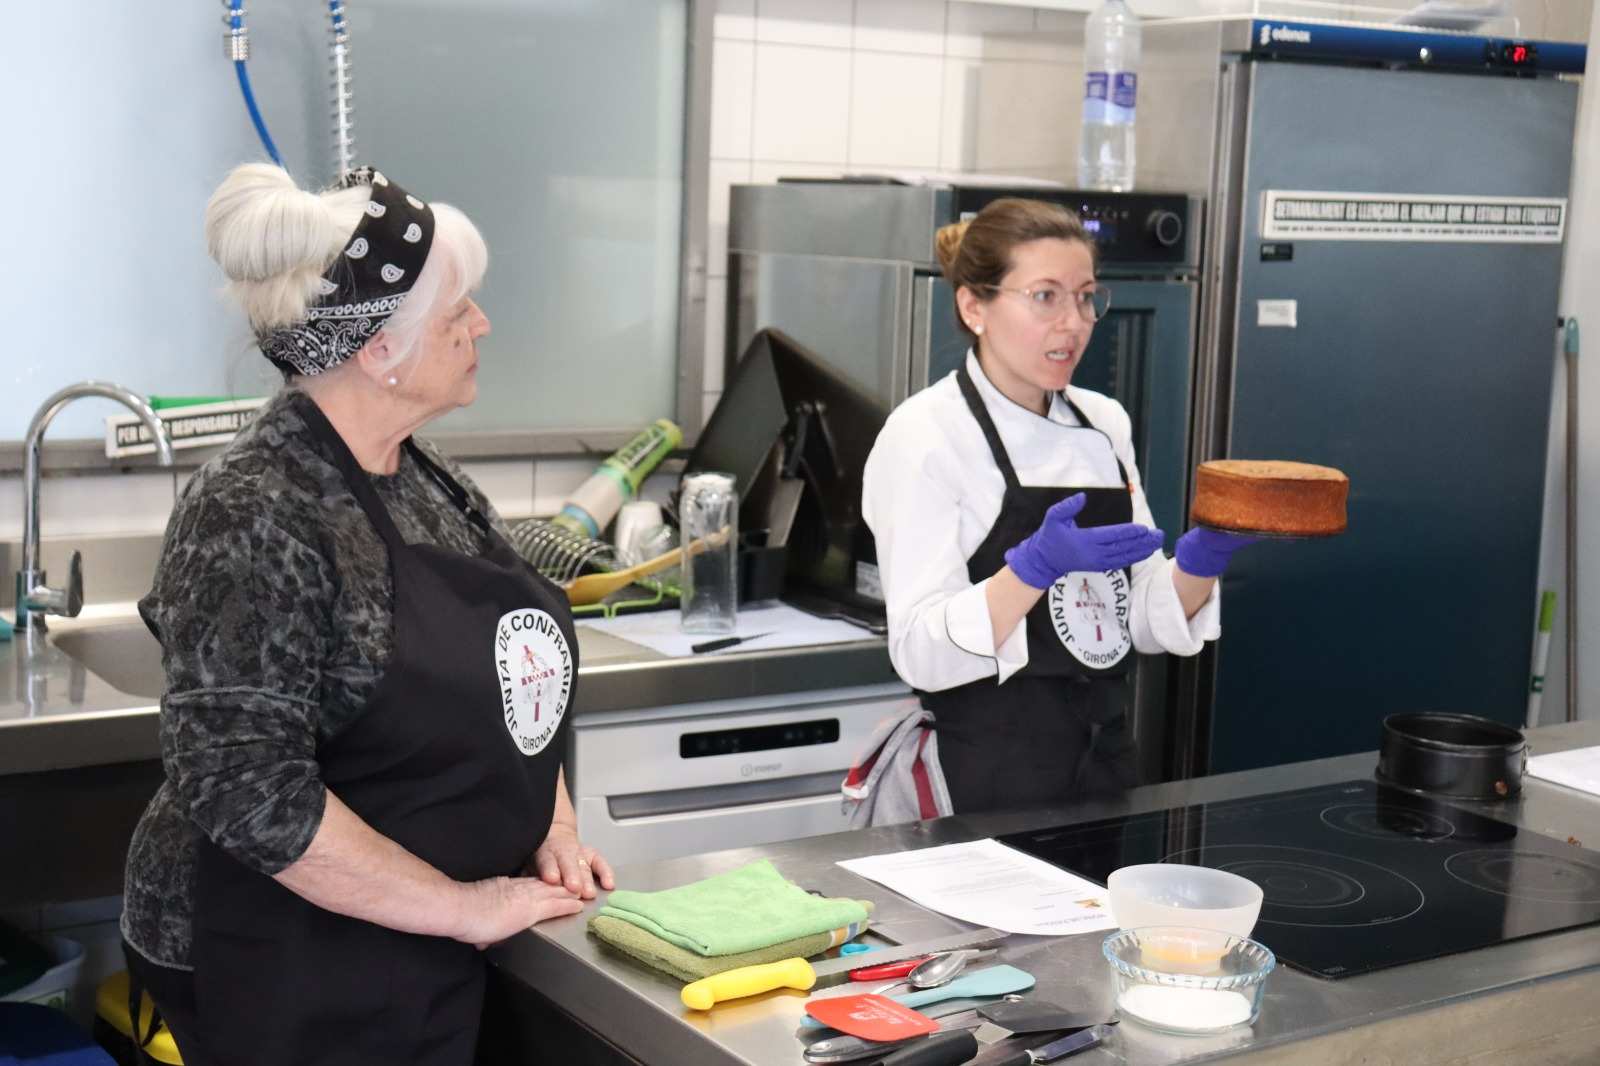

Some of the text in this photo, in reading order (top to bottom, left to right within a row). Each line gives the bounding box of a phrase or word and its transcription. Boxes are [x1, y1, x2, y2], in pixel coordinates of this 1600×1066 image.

[118, 425, 138, 445] PER
[171, 413, 239, 437] RESPONSABLE
[1053, 583, 1075, 643] JUNTA
[498, 614, 570, 732] JUNTA DE CONFRARIES
